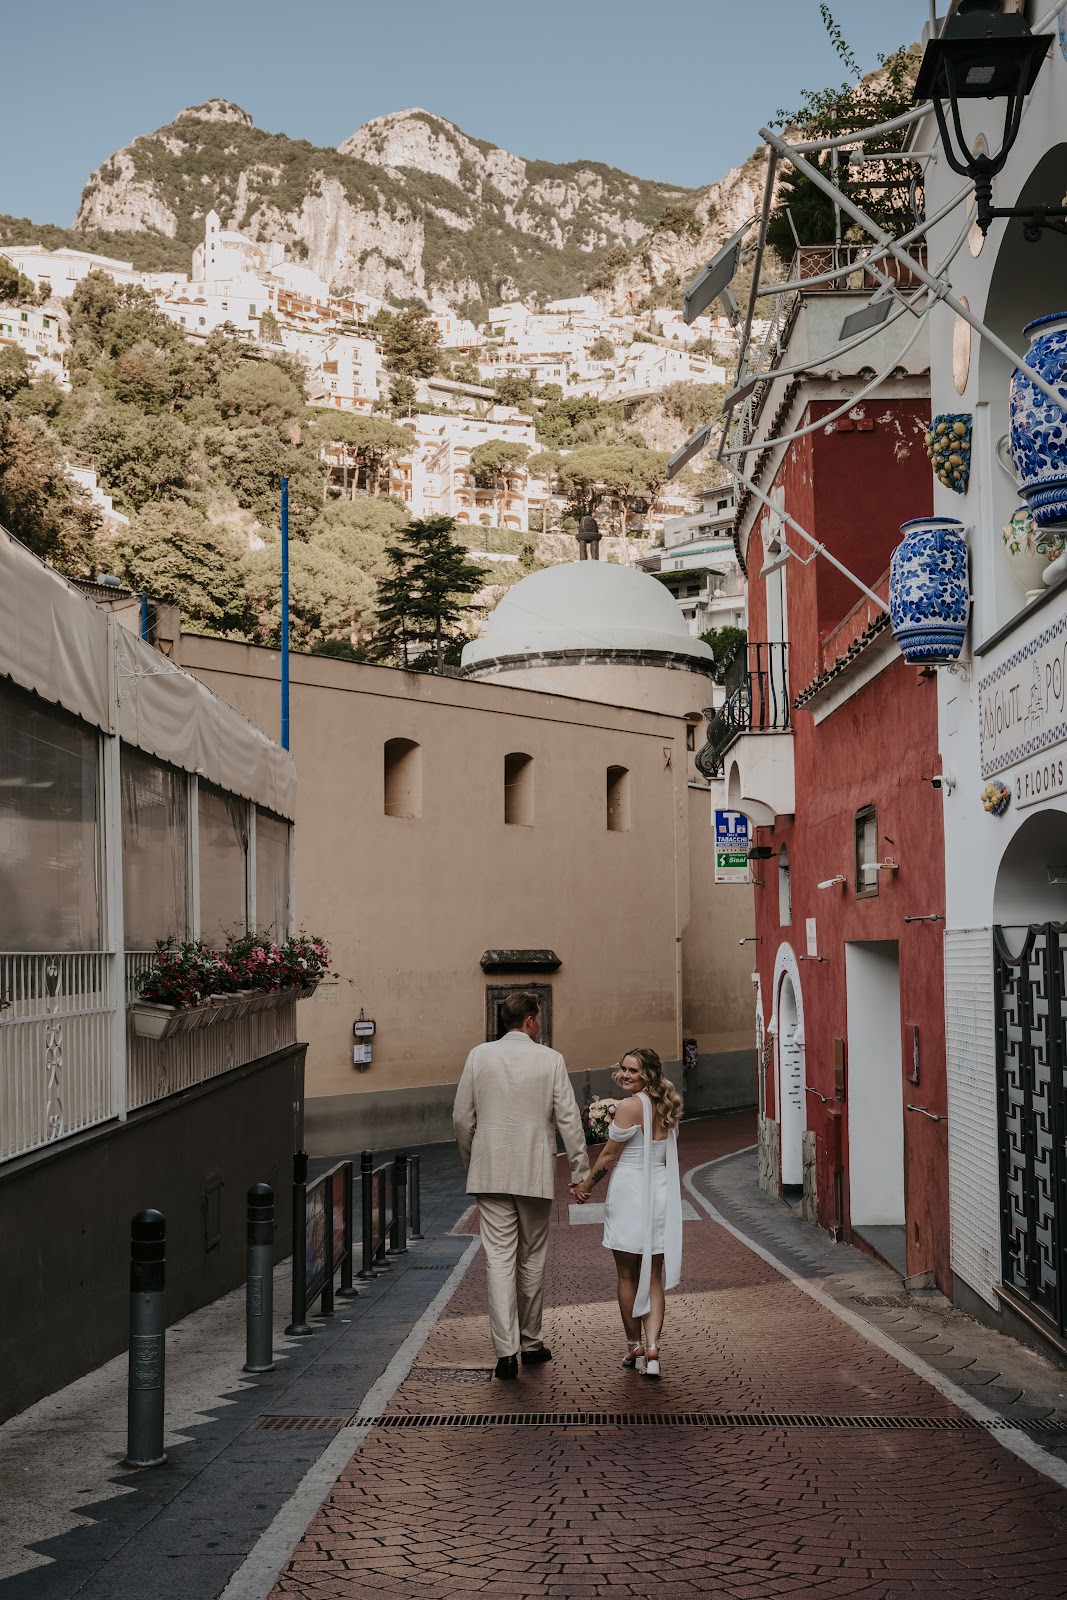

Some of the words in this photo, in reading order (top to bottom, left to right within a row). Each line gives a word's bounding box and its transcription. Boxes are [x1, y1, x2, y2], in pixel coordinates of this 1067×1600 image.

[1016, 777, 1021, 800] 3
[1025, 760, 1063, 797] FLOORS
[722, 812, 740, 833] T
